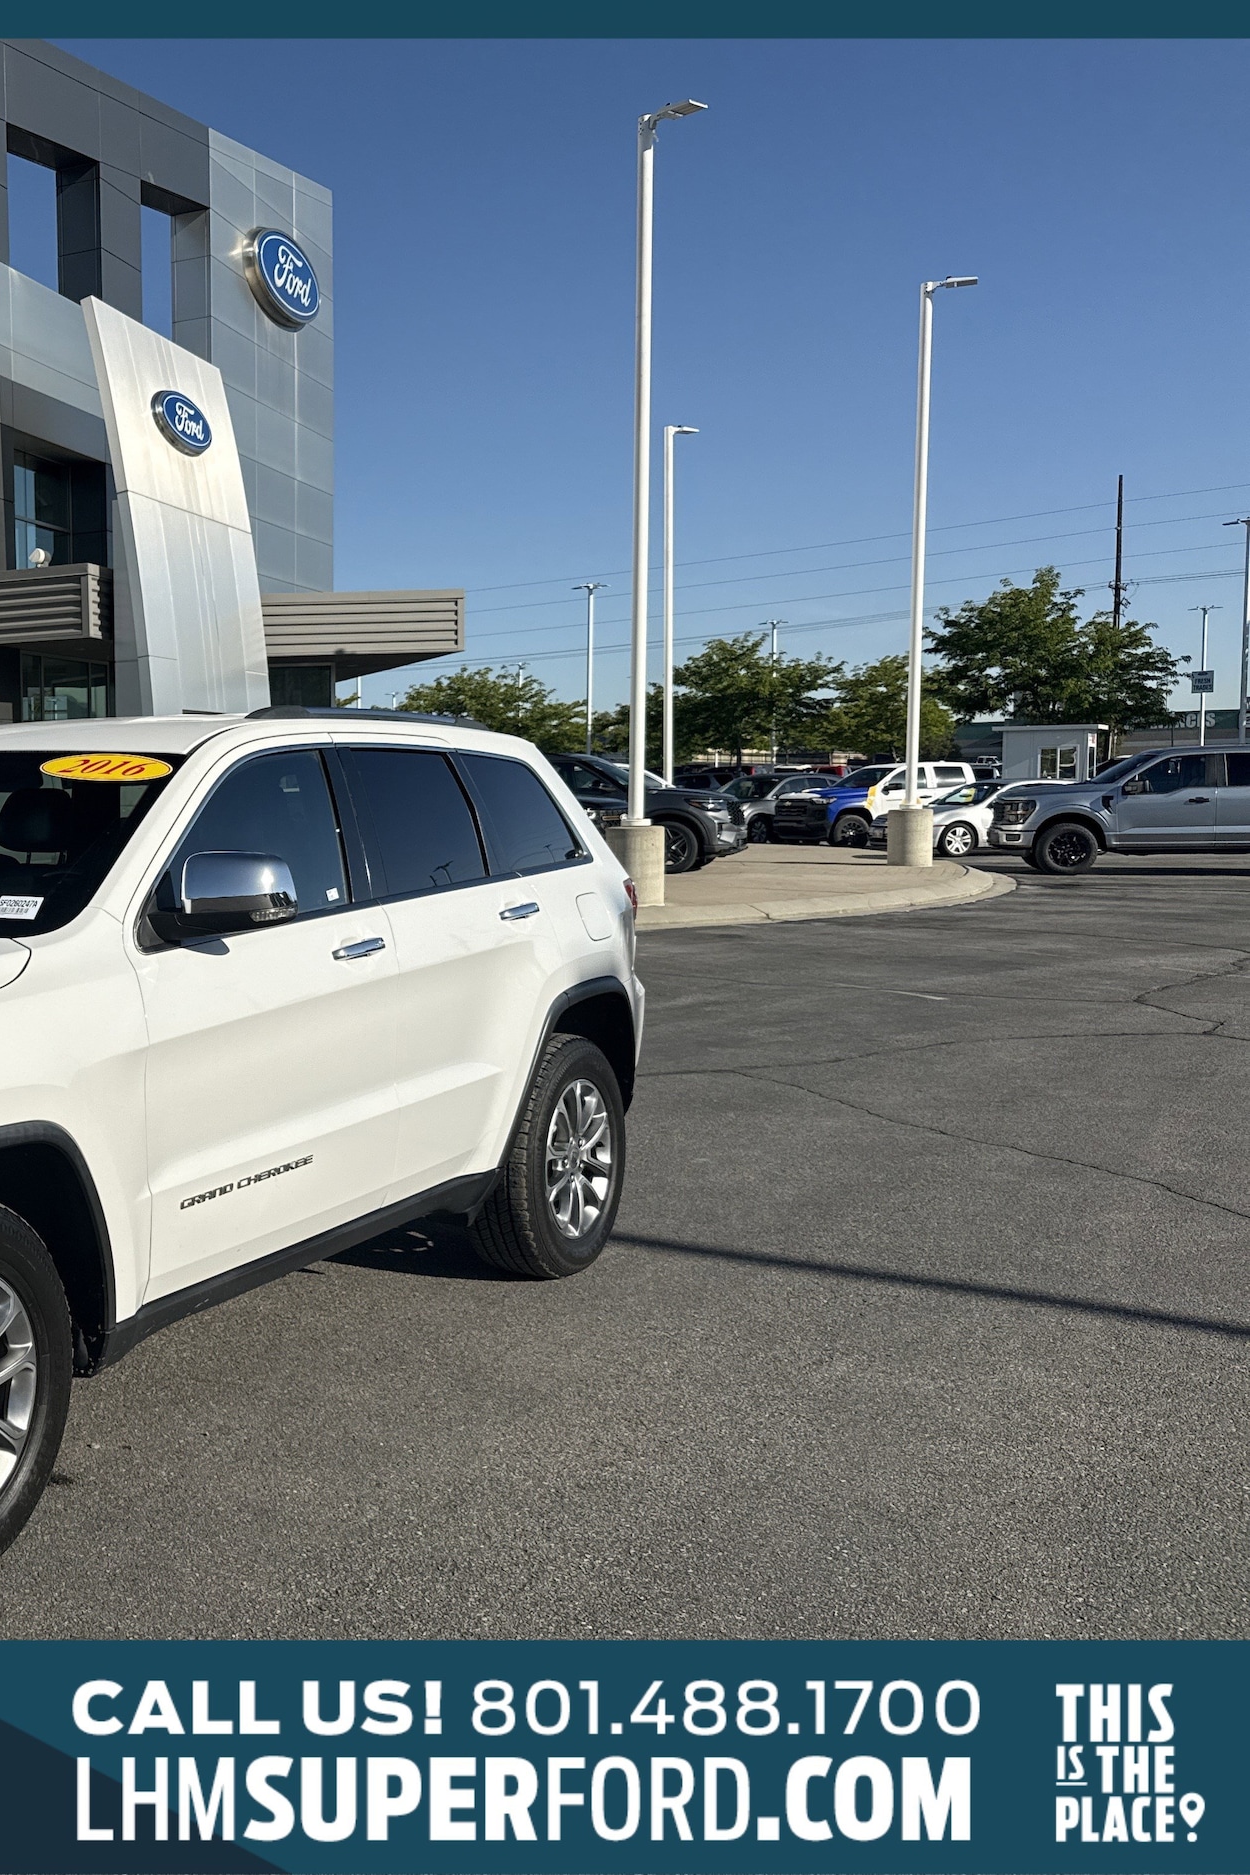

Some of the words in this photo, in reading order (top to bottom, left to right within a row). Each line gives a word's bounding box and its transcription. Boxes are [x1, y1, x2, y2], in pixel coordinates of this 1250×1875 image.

[273, 244, 312, 307] Ford
[175, 401, 205, 441] Ford
[57, 759, 157, 776] 2016
[180, 1182, 234, 1210] GRAND
[237, 1154, 314, 1189] CHEROKEE
